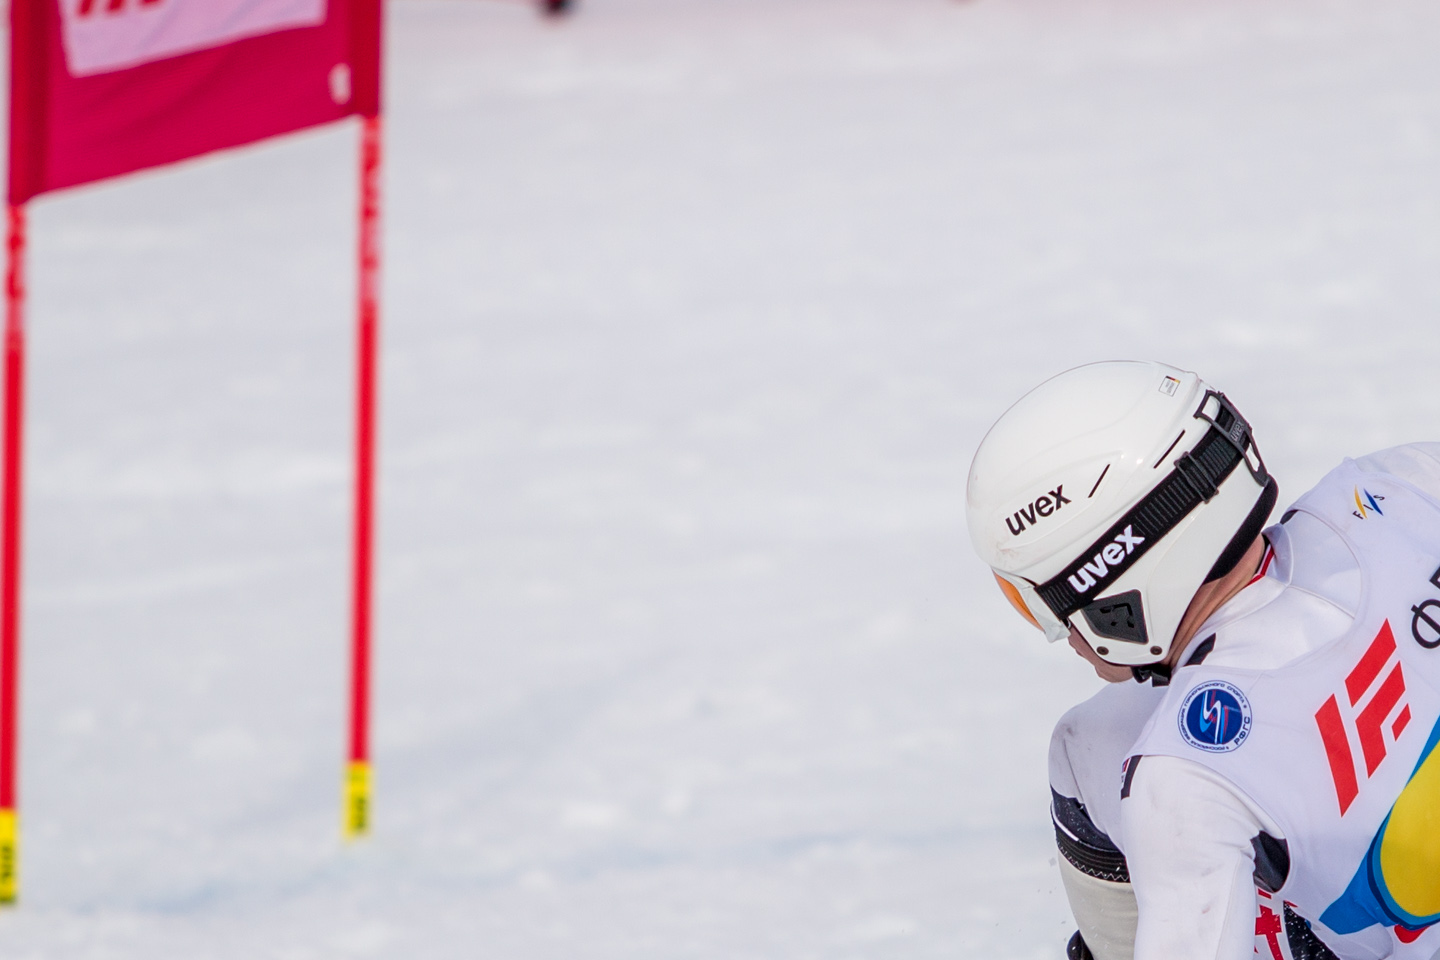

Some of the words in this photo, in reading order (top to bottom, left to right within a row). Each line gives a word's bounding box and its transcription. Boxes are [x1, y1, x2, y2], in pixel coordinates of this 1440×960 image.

[1004, 484, 1072, 536] uvex
[1067, 524, 1146, 593] uvex
[1234, 716, 1251, 745] РФГС
